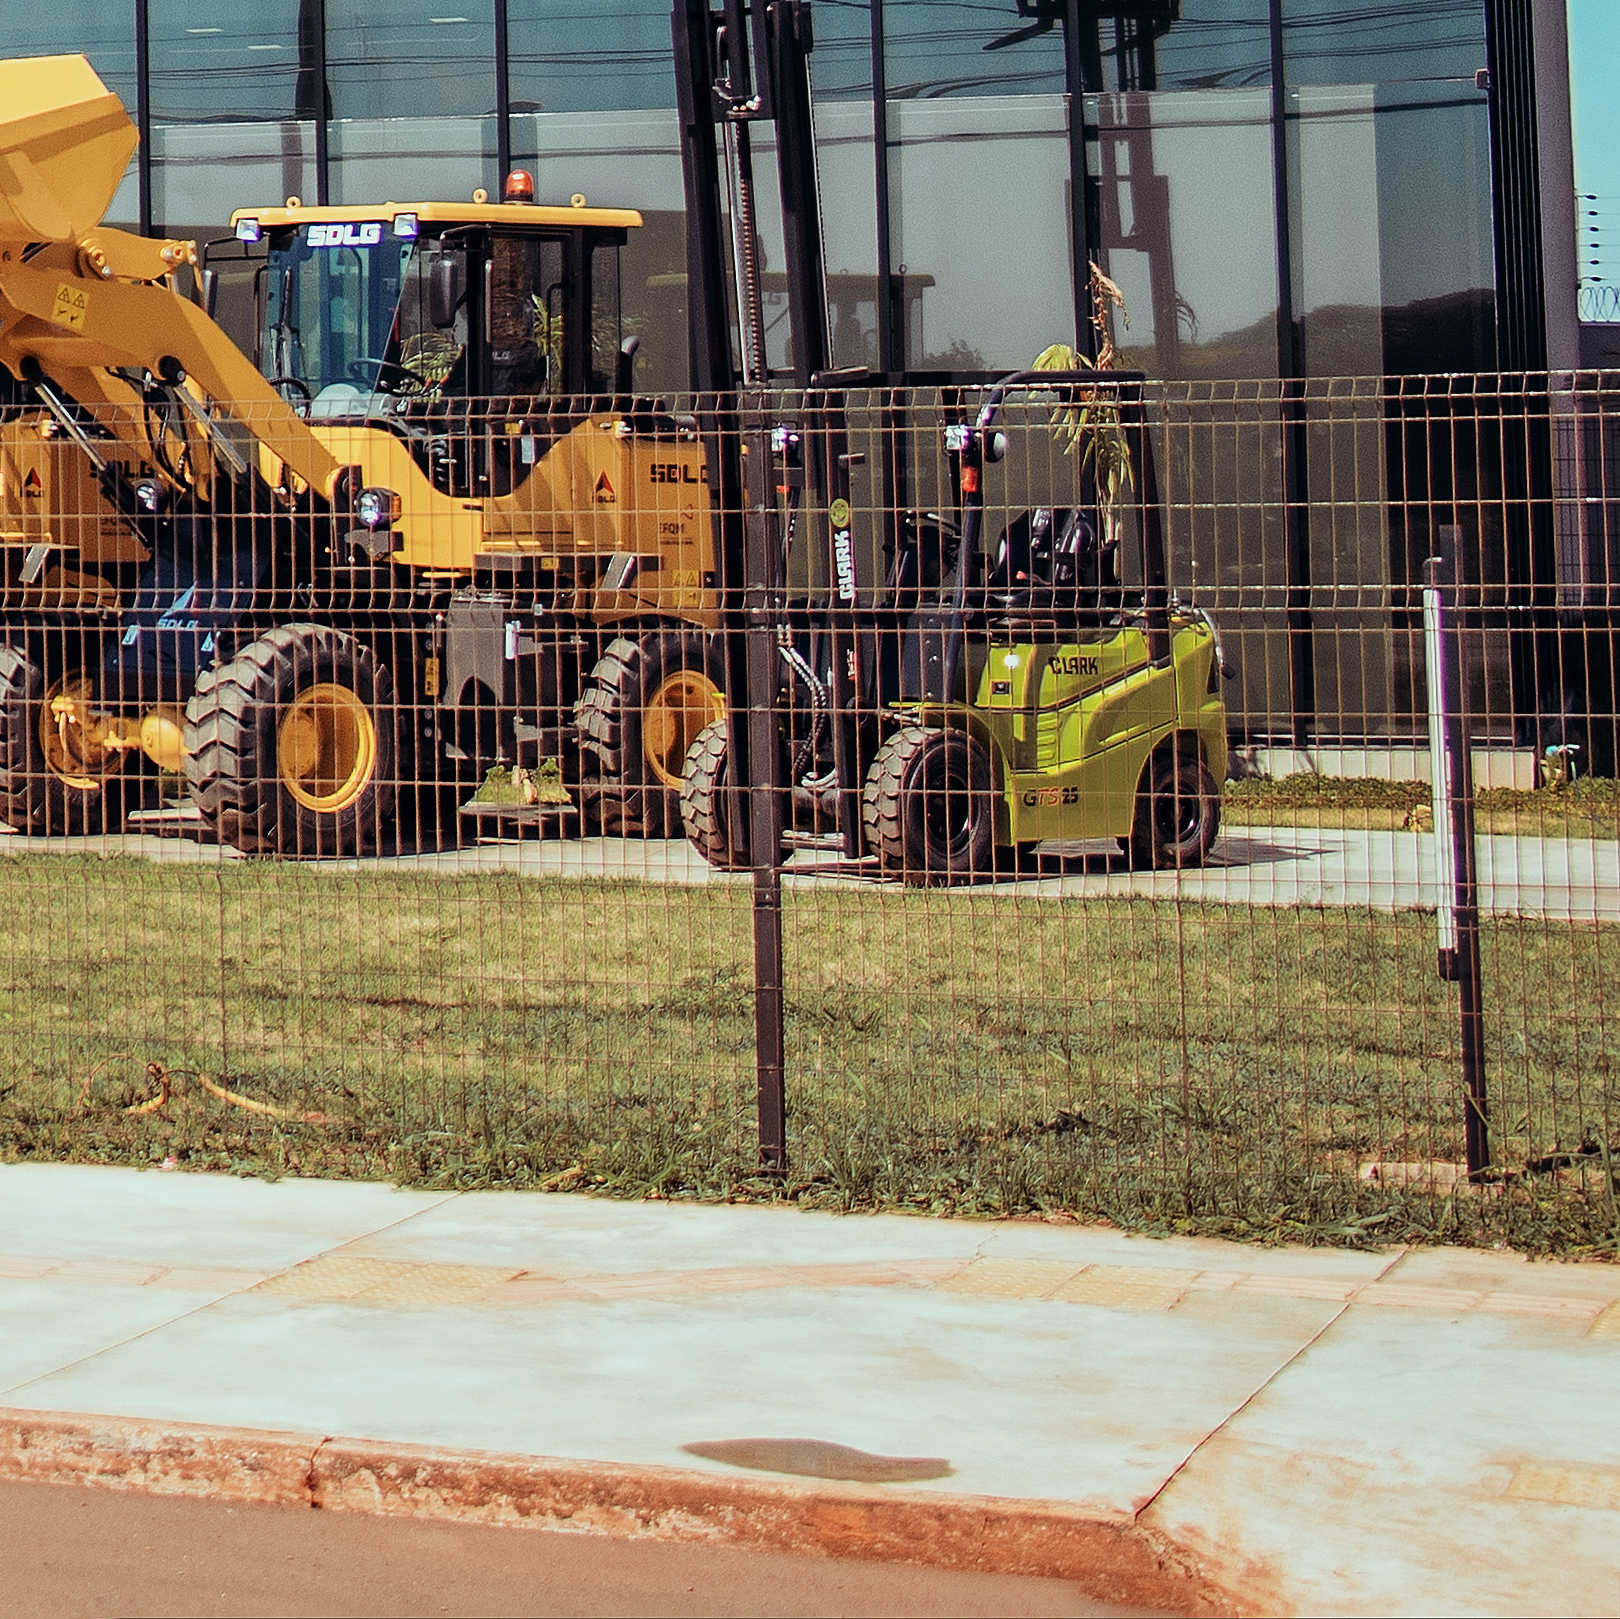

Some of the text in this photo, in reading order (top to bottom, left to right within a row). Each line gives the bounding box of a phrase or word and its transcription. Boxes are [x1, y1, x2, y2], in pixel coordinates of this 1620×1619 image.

[306, 223, 382, 247] SDLG
[834, 530, 855, 600] CLARK
[1047, 656, 1099, 675] CLARK
